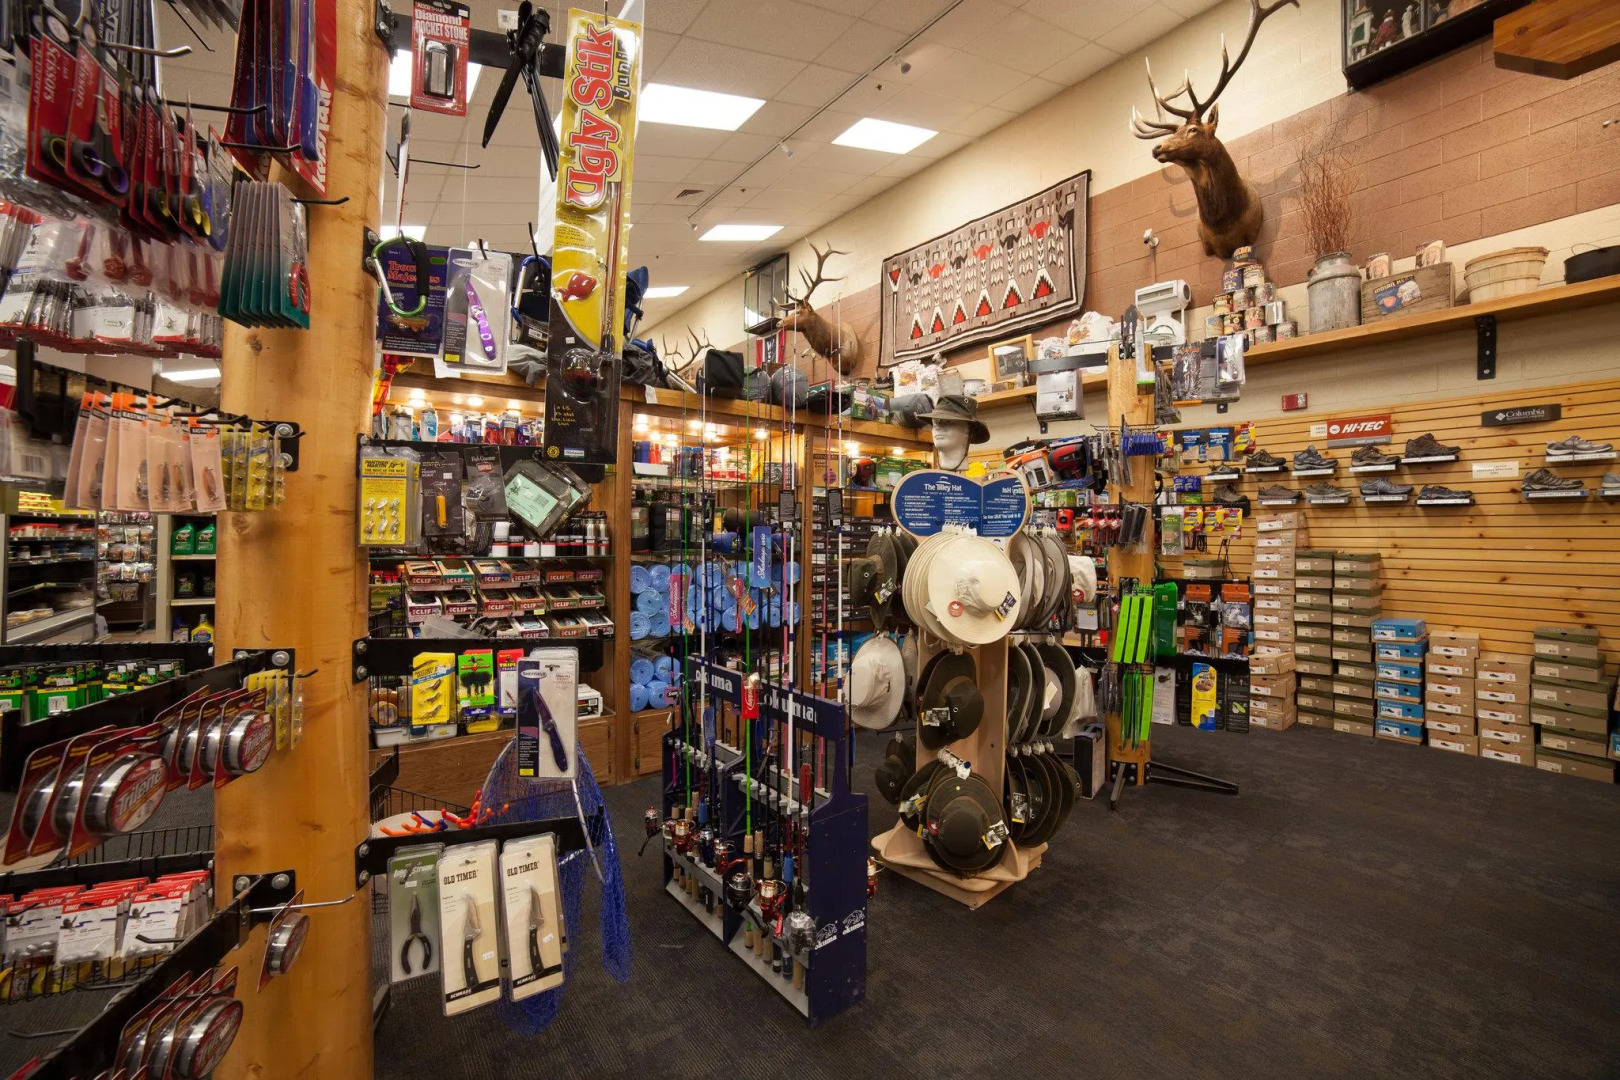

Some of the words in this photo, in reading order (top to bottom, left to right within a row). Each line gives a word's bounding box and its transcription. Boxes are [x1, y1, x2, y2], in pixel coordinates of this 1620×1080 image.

[415, 9, 463, 26] Diamond
[445, 26, 469, 40] STONE
[571, 23, 616, 109] Stik
[565, 110, 618, 208] Ugly
[1505, 409, 1545, 418] Columbia
[1342, 420, 1385, 434] HI-TEC
[924, 483, 936, 491] The
[936, 483, 951, 492] Tilley
[952, 484, 962, 492] Hat
[507, 867, 518, 877] OLD
[519, 862, 538, 874] TIMER
[443, 874, 455, 885] OLD
[457, 870, 477, 882] TIMER
